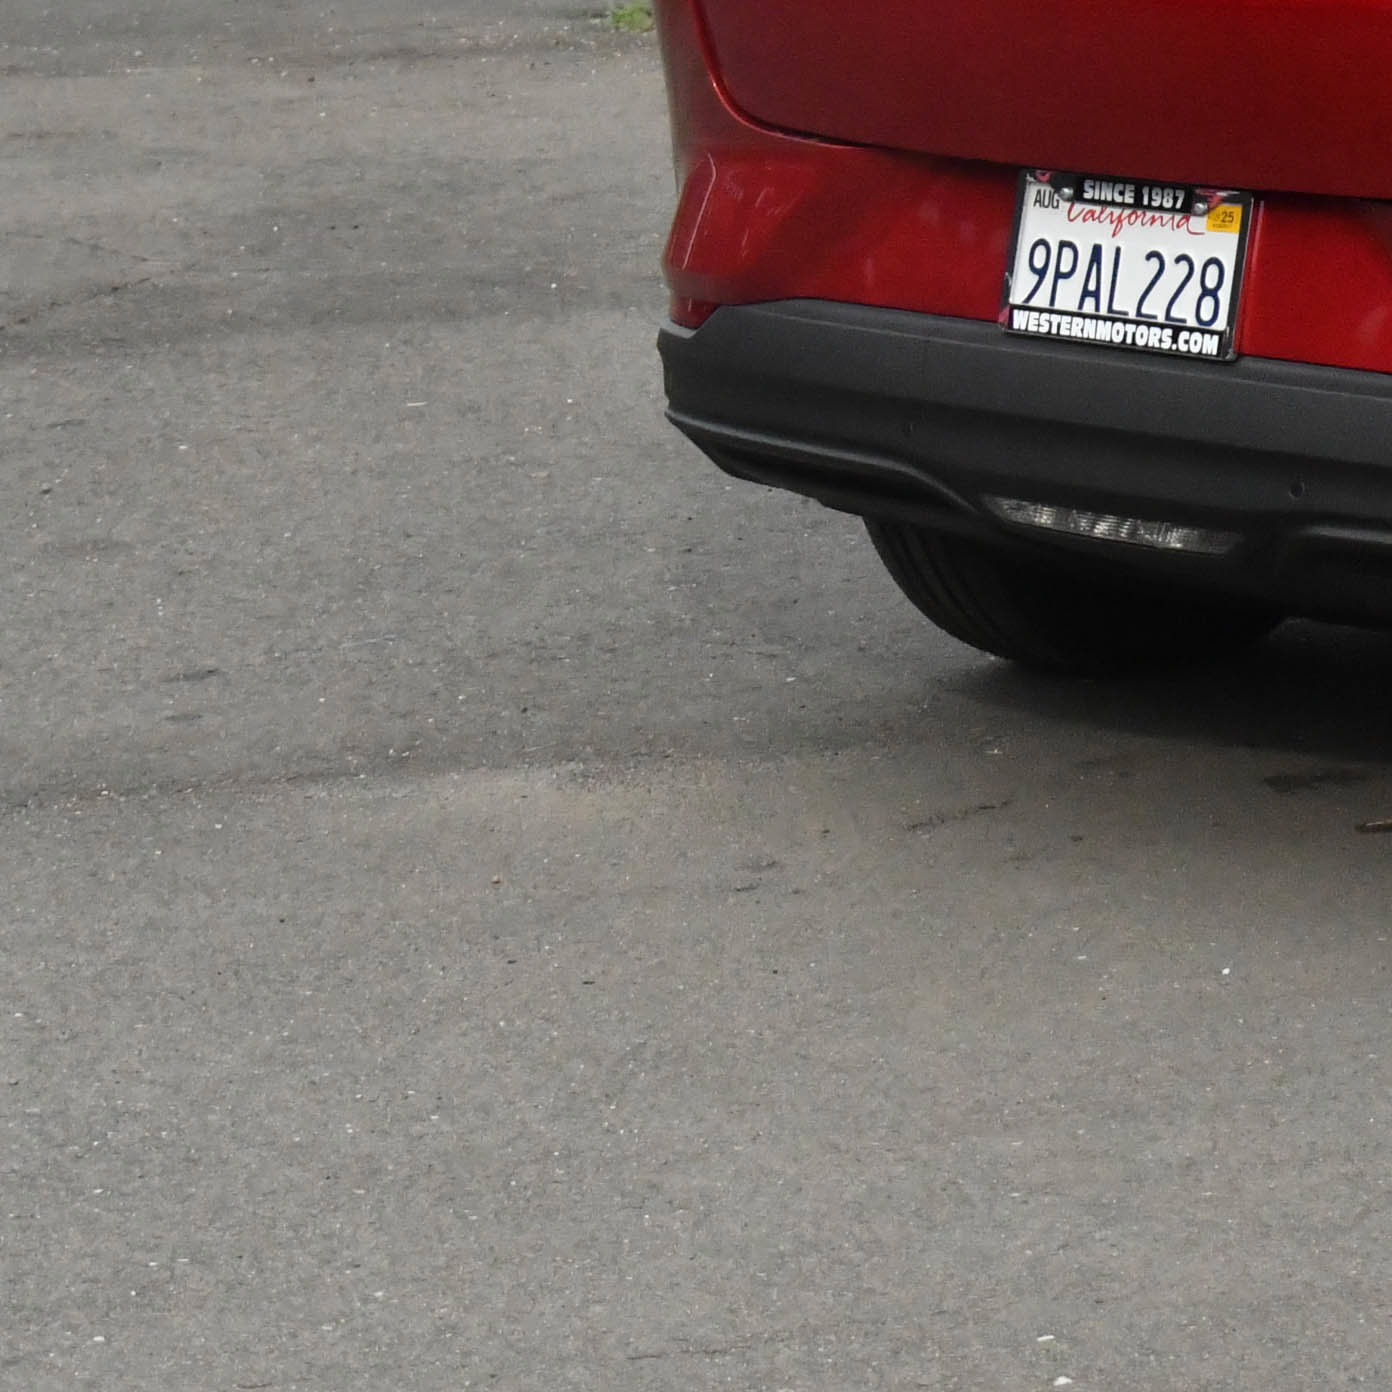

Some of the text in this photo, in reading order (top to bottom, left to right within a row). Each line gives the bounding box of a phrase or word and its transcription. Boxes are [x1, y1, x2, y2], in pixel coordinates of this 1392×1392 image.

[1032, 188, 1061, 209] AUG
[1083, 179, 1186, 209] SINCE 1987
[1066, 202, 1206, 239] California
[1221, 210, 1235, 224] 25
[1022, 237, 1226, 327] 9PAL228
[1011, 309, 1221, 356] WESTERNMOTORS.COM
